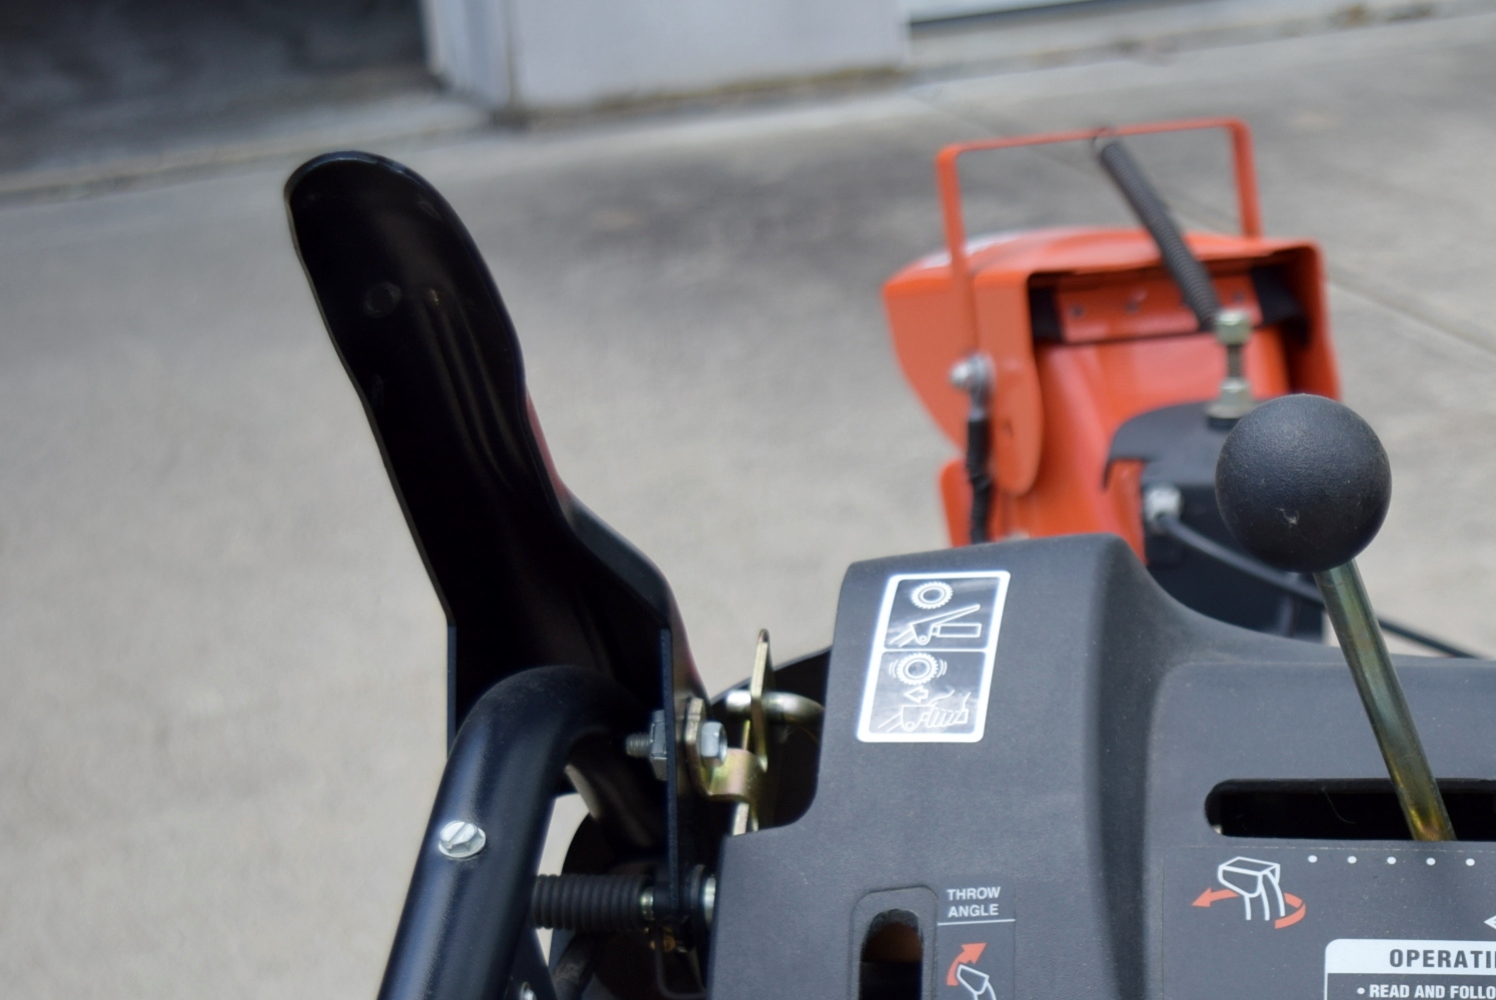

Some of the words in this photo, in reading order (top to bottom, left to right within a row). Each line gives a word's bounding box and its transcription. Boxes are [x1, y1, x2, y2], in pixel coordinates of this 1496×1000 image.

[947, 887, 1000, 900] THROW
[948, 904, 998, 917] ANGLE
[1370, 985, 1409, 997] READ
[1415, 985, 1445, 998] AND
